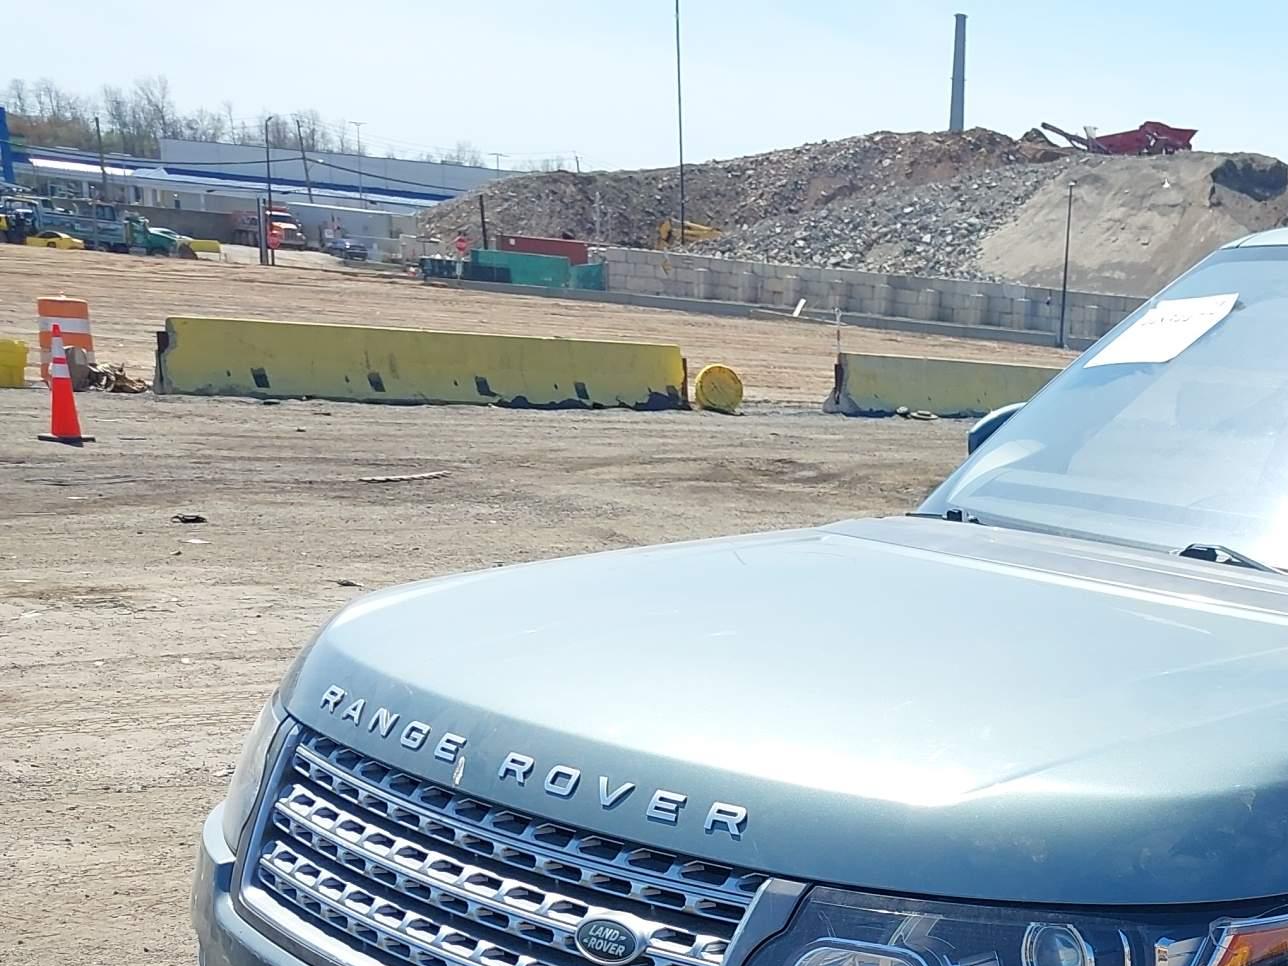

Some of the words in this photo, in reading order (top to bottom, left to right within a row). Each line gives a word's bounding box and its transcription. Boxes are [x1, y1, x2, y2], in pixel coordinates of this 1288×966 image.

[319, 684, 467, 761] RANGE
[497, 752, 749, 839] ROVER
[589, 924, 620, 941] LAND
[587, 937, 626, 957] ROVER
